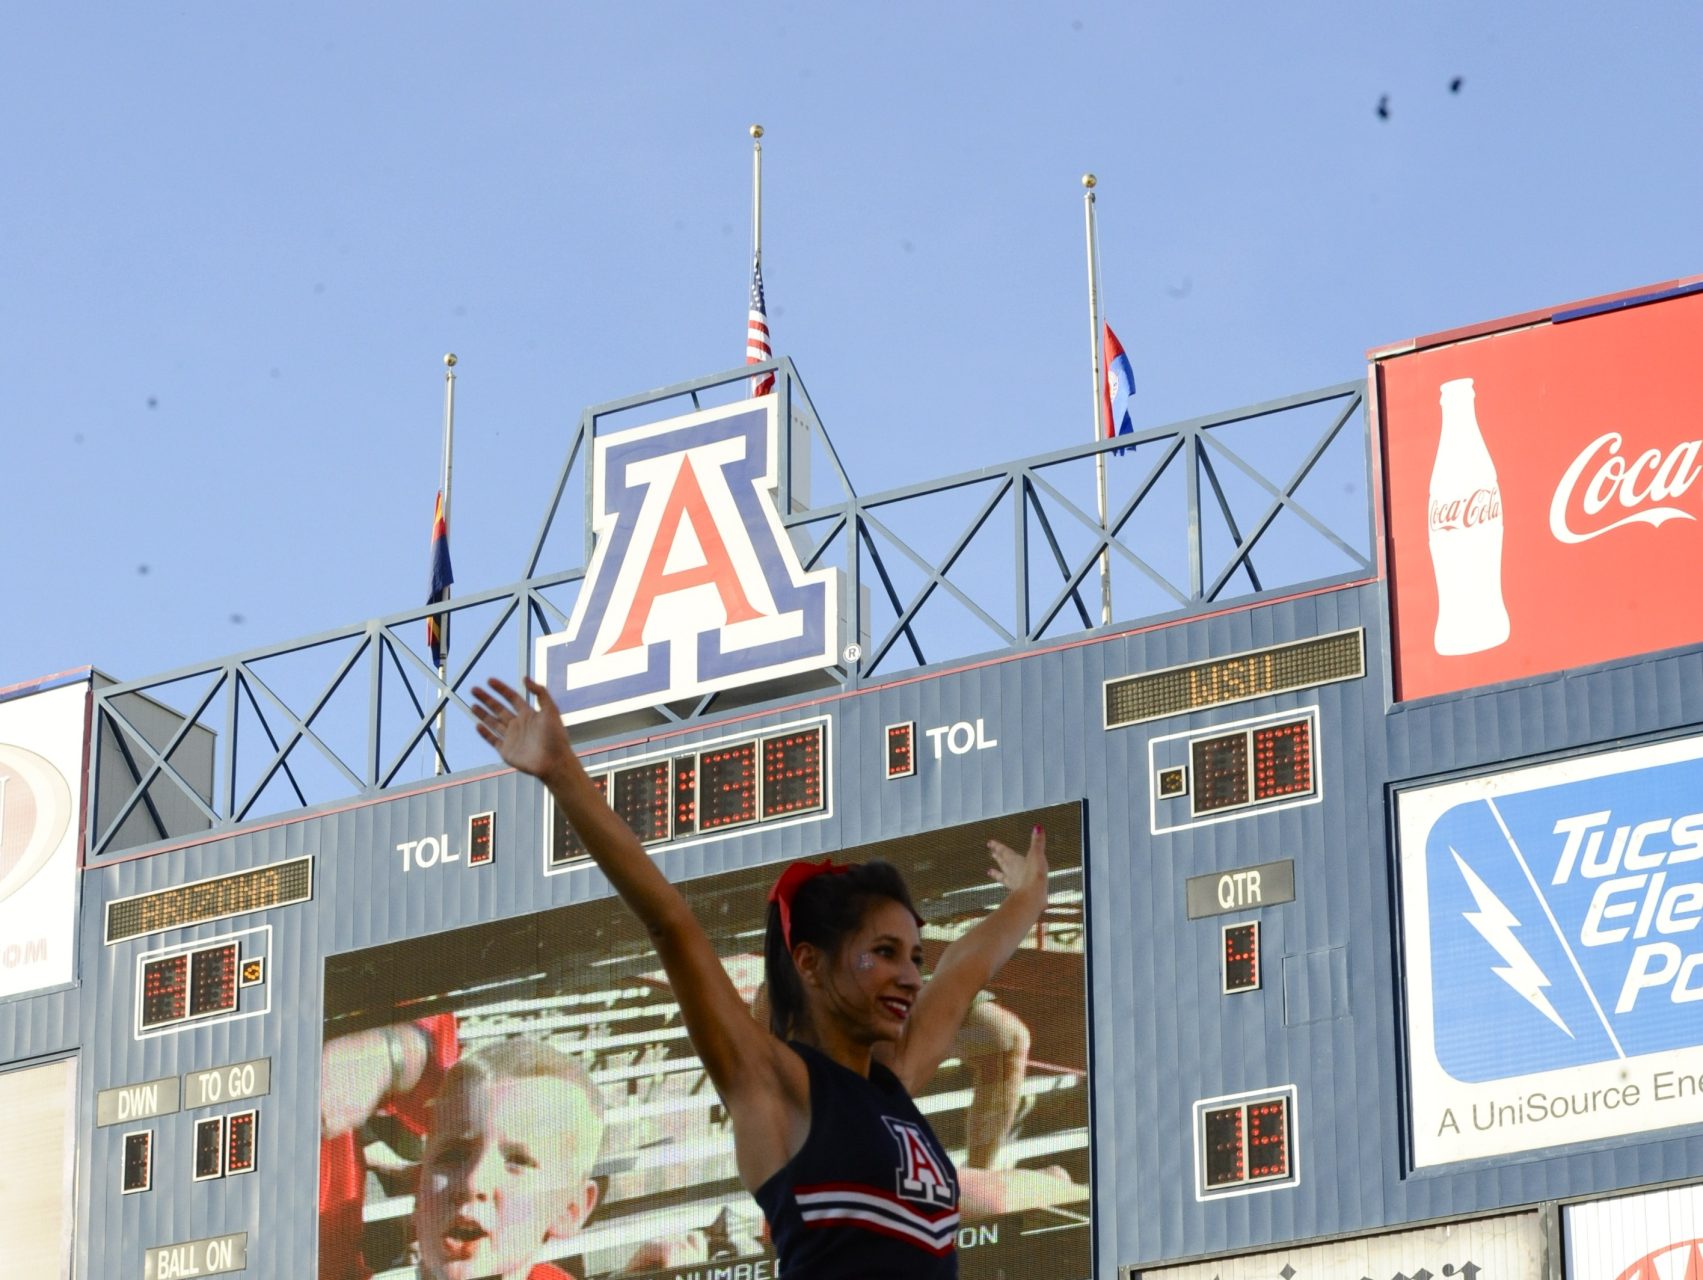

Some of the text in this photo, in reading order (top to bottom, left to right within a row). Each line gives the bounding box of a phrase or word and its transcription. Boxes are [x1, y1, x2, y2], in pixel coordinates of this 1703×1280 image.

[1191, 655, 1271, 708] WSU
[889, 728, 911, 774] 3
[925, 719, 997, 760] TOL
[396, 834, 459, 871] TOL
[471, 818, 492, 862] 3
[141, 870, 278, 932] ARIZONA
[1217, 870, 1262, 909] QTR
[1580, 871, 1703, 947] Ele
[1227, 926, 1257, 984] 4
[117, 1084, 158, 1120] DWN
[199, 1064, 255, 1103] TO GO
[1438, 1070, 1703, 1136] A UniSource En
[157, 1239, 232, 1280] BALL ON
